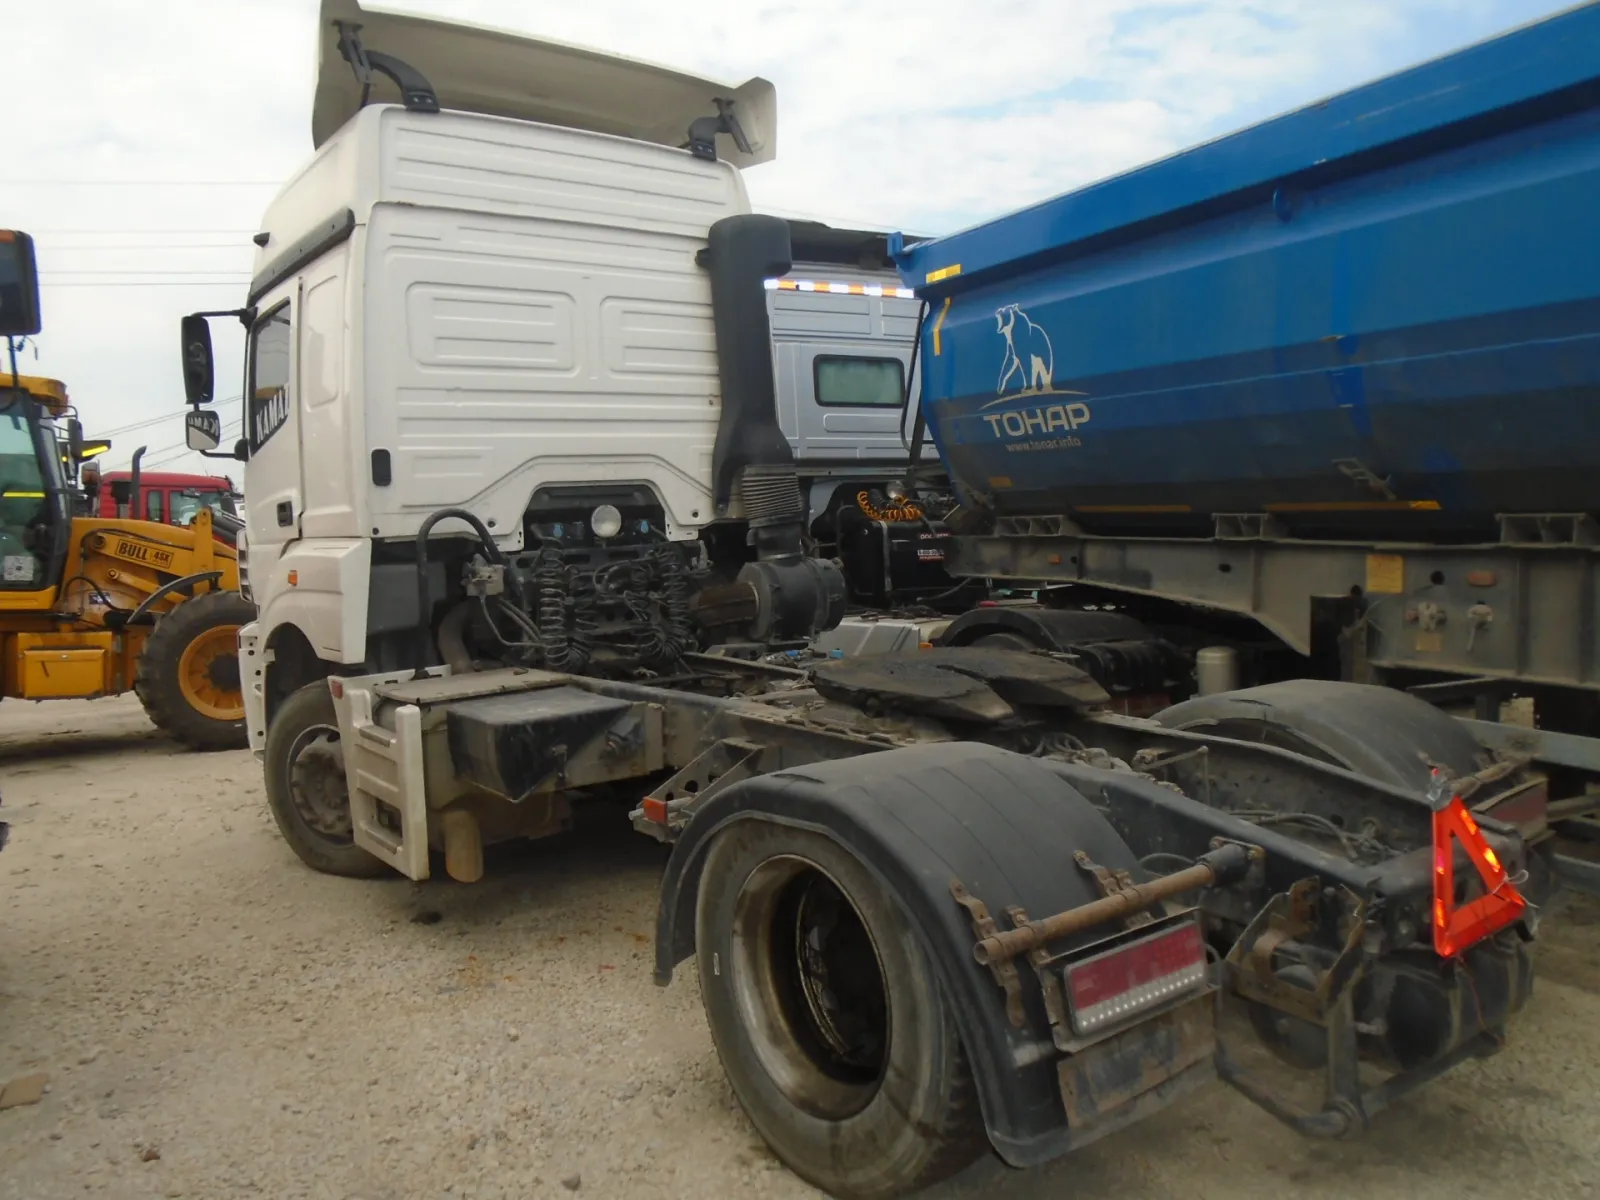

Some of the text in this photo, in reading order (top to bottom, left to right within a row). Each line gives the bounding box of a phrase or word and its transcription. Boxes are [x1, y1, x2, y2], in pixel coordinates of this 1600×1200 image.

[983, 403, 1091, 438] ТОНАР
[1005, 435, 1082, 453] www.tonar.info
[118, 542, 148, 561] BULL
